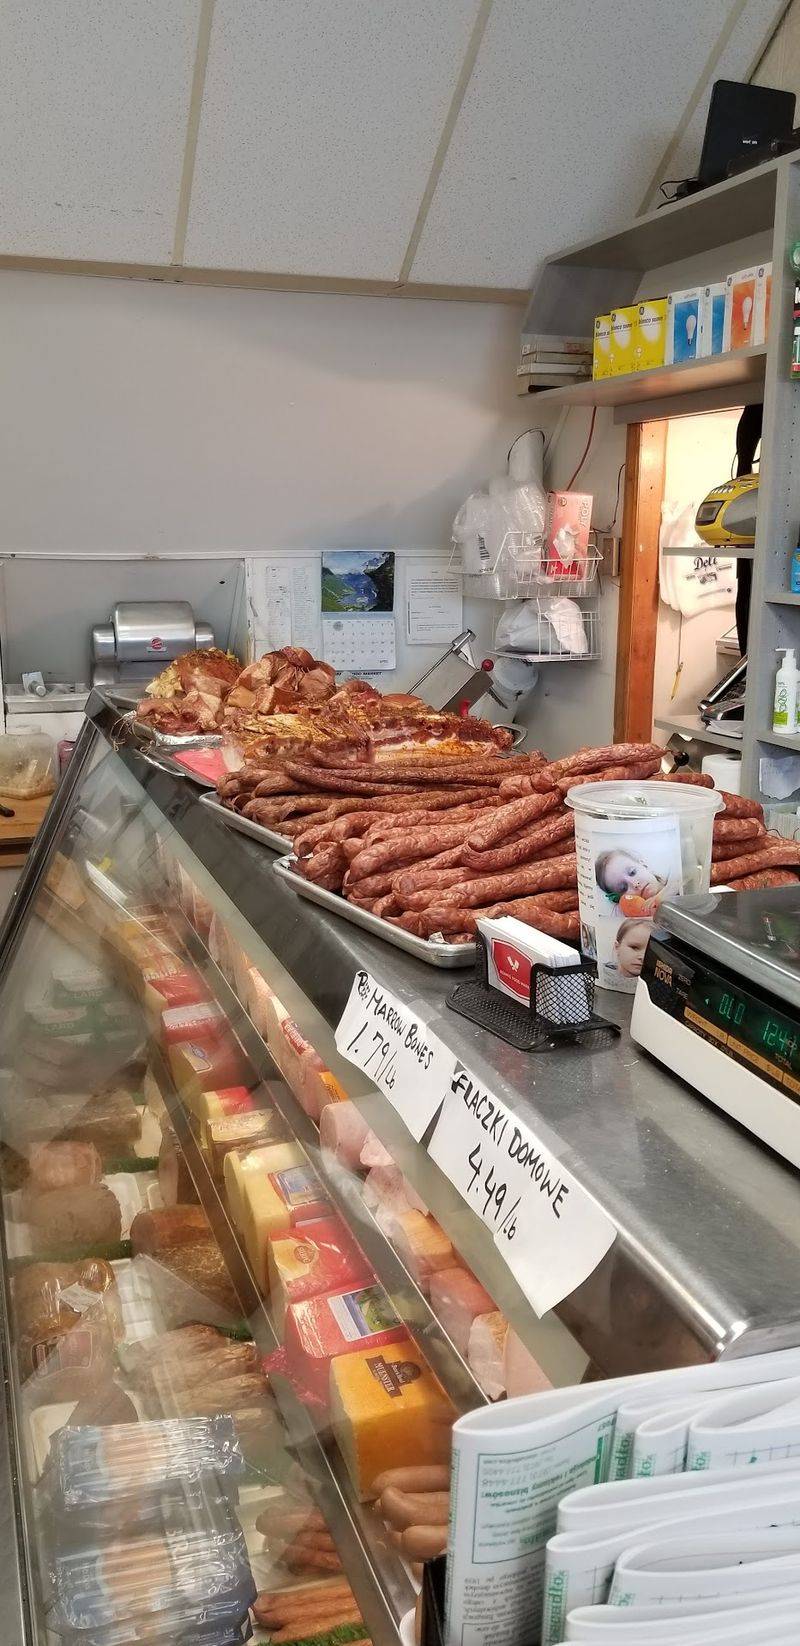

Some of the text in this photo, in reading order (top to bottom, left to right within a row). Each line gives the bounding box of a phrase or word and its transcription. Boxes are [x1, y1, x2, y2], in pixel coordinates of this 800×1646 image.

[366, 987, 434, 1070] MARROW BONES
[451, 1074, 569, 1219] FLACZKI DOMOWE
